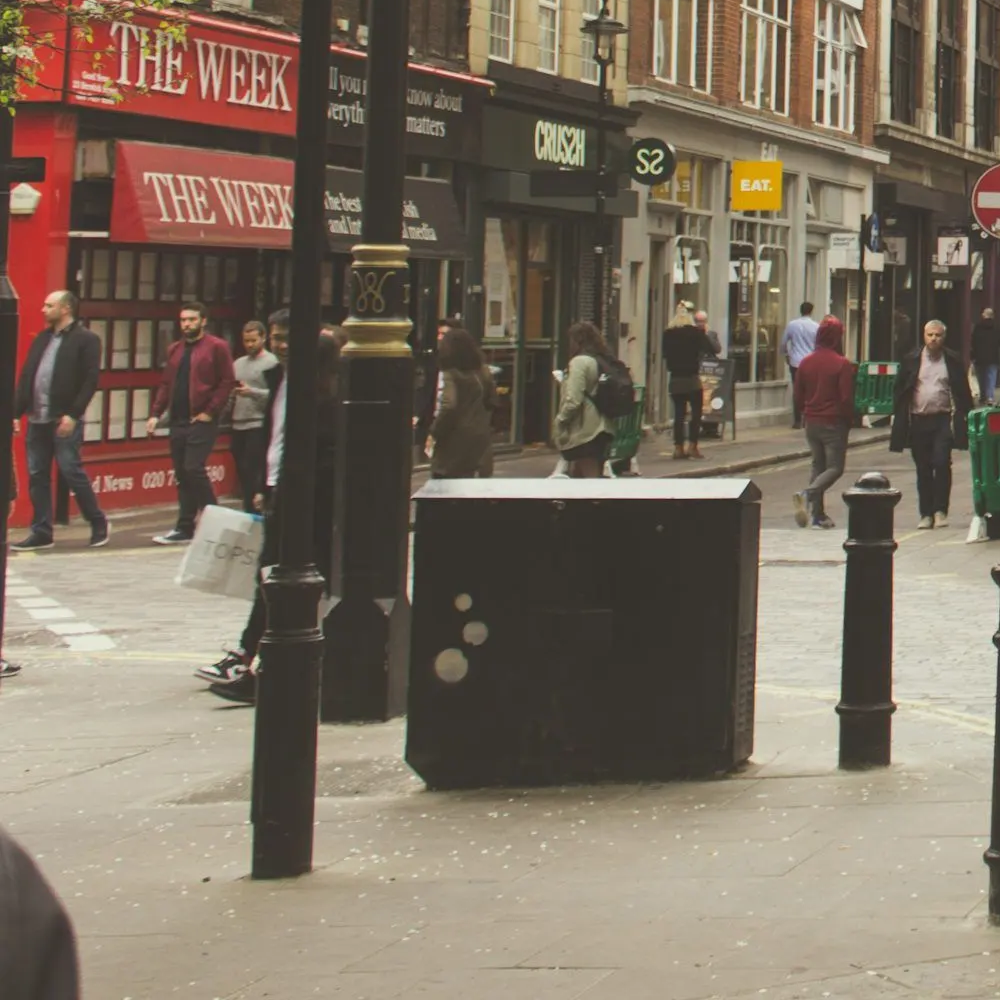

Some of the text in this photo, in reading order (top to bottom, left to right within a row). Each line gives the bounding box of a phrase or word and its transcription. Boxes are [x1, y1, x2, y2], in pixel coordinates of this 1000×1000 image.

[110, 21, 293, 112] THE WEEK
[338, 73, 362, 97] you
[433, 88, 464, 113] about
[405, 115, 446, 138] matters
[534, 119, 586, 168] CRUSSH
[143, 172, 295, 230] THE WEEK
[740, 178, 773, 192] EAT.
[102, 474, 134, 493] News
[141, 470, 166, 490] 020
